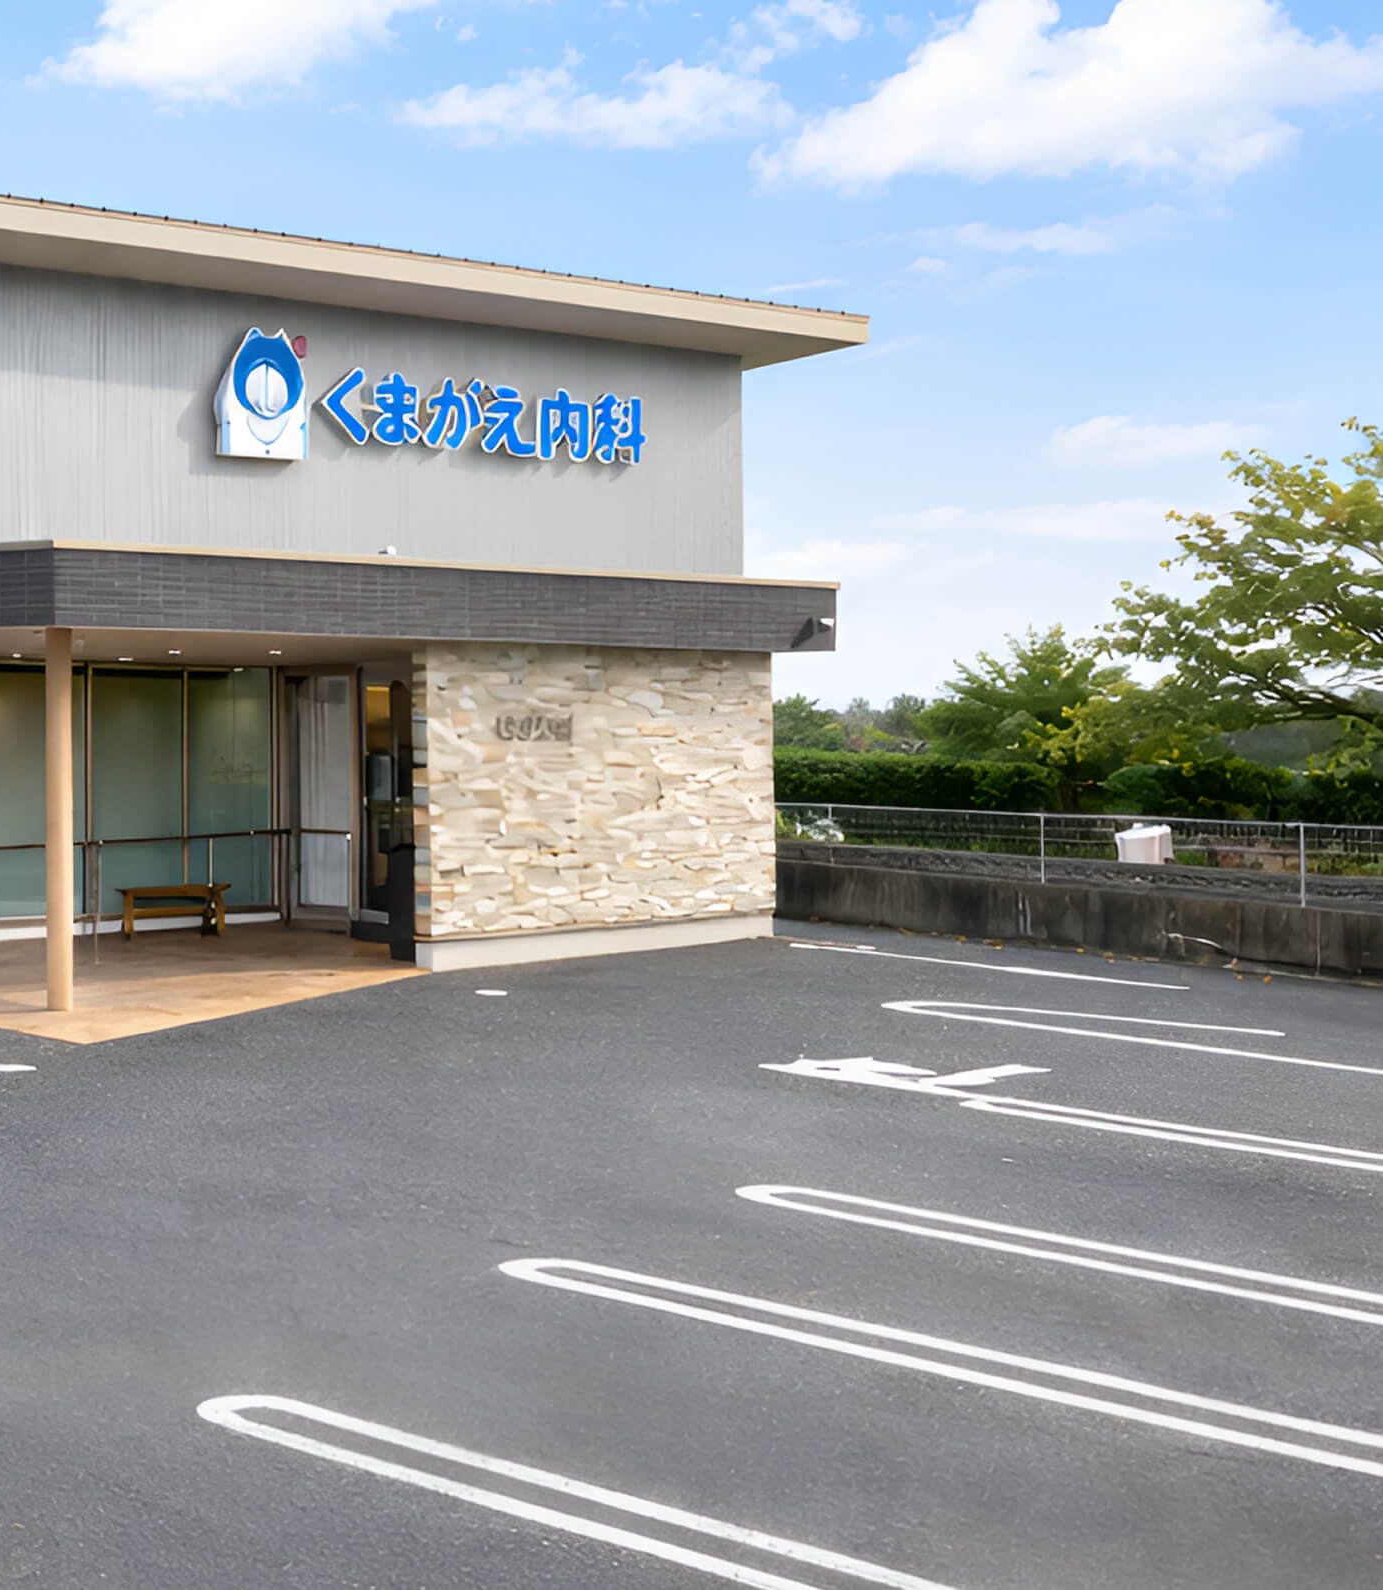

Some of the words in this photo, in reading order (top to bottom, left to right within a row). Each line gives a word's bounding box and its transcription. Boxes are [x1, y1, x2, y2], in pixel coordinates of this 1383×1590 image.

[320, 367, 647, 464] くまがえ内科
